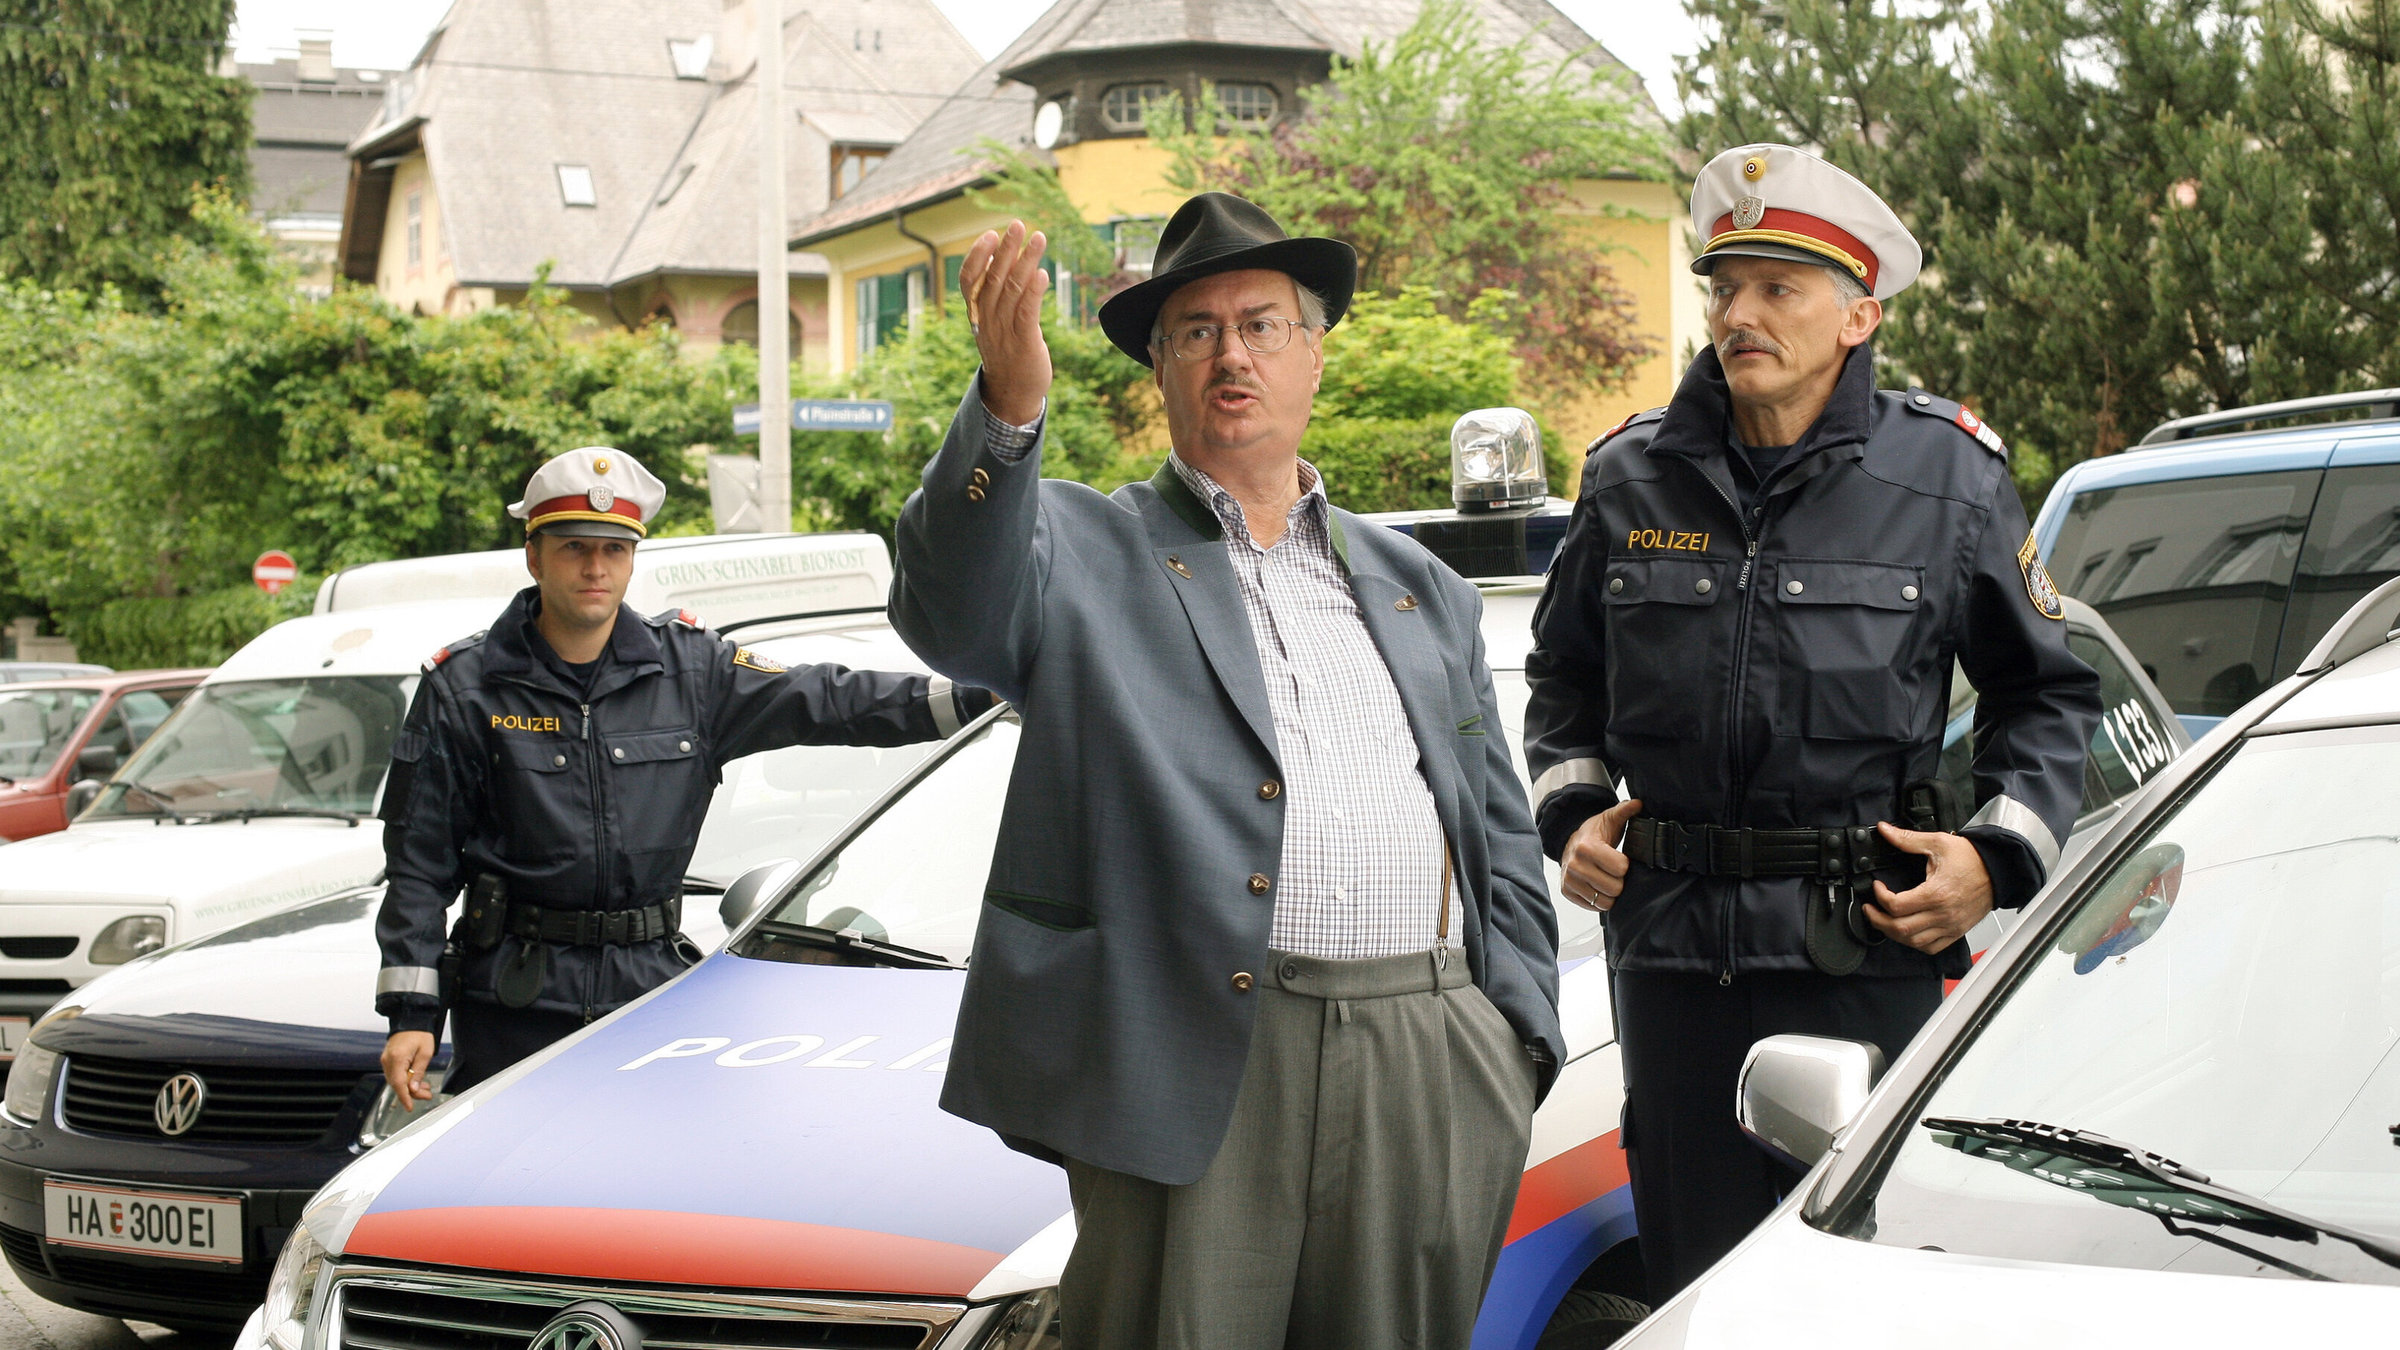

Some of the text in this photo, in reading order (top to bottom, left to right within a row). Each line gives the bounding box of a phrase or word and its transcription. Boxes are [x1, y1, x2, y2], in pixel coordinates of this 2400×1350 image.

[1627, 529, 1710, 552] POLIZEI
[801, 548, 866, 573] BIOKOST
[1738, 560, 1751, 588] POLIZEI
[491, 714, 560, 732] POLIZEI
[2113, 698, 2165, 773] 133
[615, 1034, 952, 1072] POLI
[67, 1195, 103, 1237] HA
